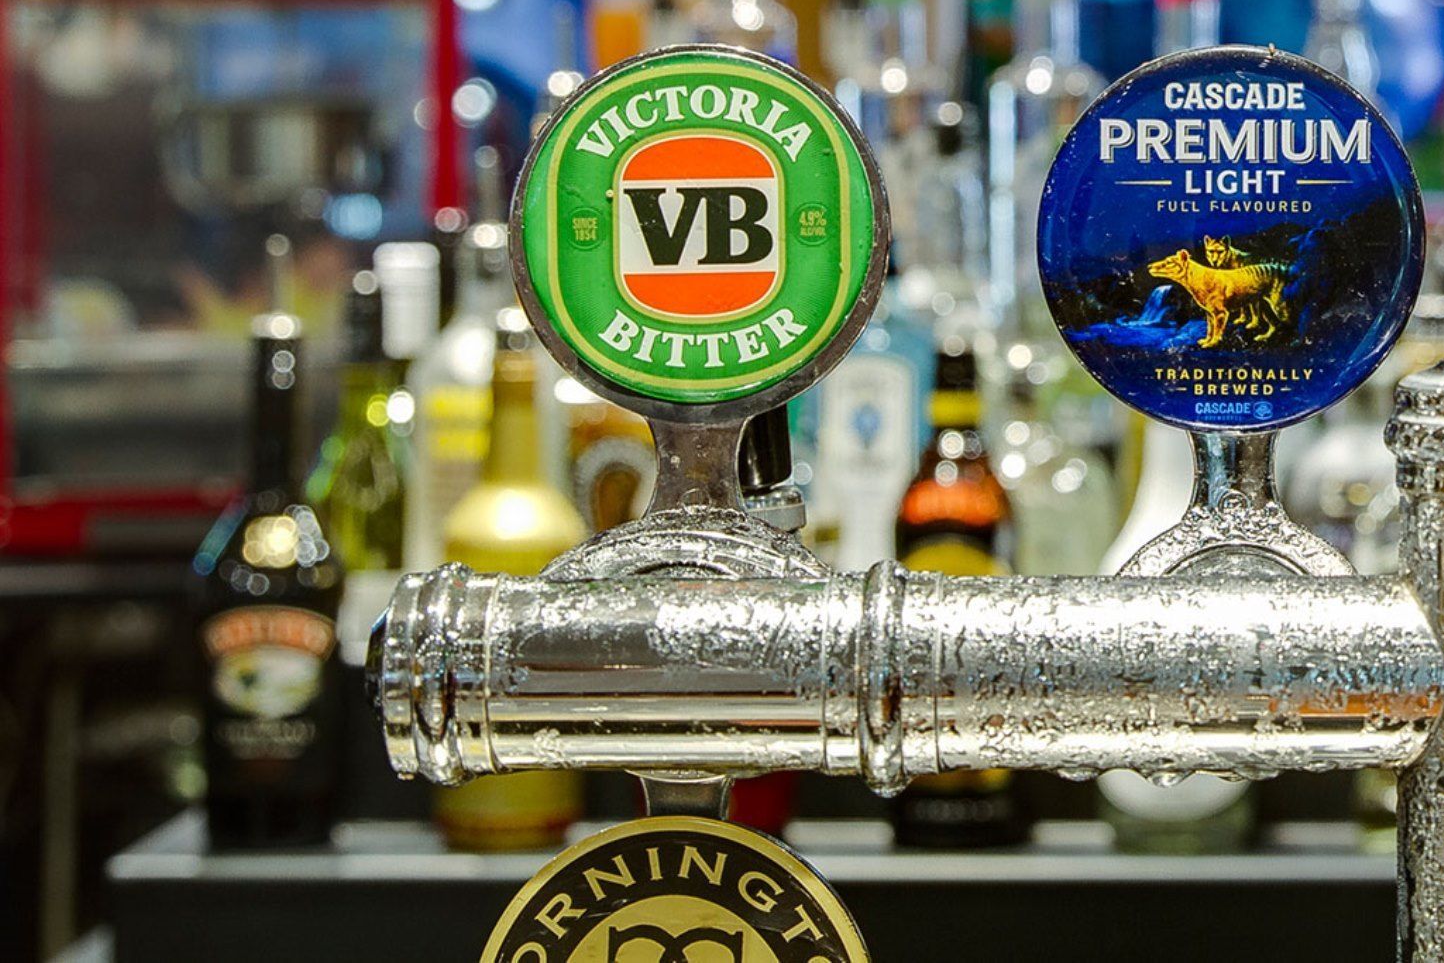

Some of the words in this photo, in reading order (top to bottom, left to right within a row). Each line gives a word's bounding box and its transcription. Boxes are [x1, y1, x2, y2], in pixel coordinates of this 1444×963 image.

[1164, 82, 1306, 110] CASCADE
[576, 84, 814, 163] VICTORIA
[1099, 118, 1372, 164] PREMIUM
[1184, 169, 1286, 195] LIGHT
[799, 211, 828, 226] 4.9%
[1156, 199, 1200, 213] FULL
[1210, 199, 1312, 213] FLAVOURED
[623, 186, 774, 266] VB
[598, 306, 809, 369] BITTER
[1155, 368, 1313, 380] TRADITIONALLY
[1194, 383, 1274, 396] BREWED
[1195, 402, 1251, 415] CASCADE
[511, 846, 836, 963] ORNINGT
